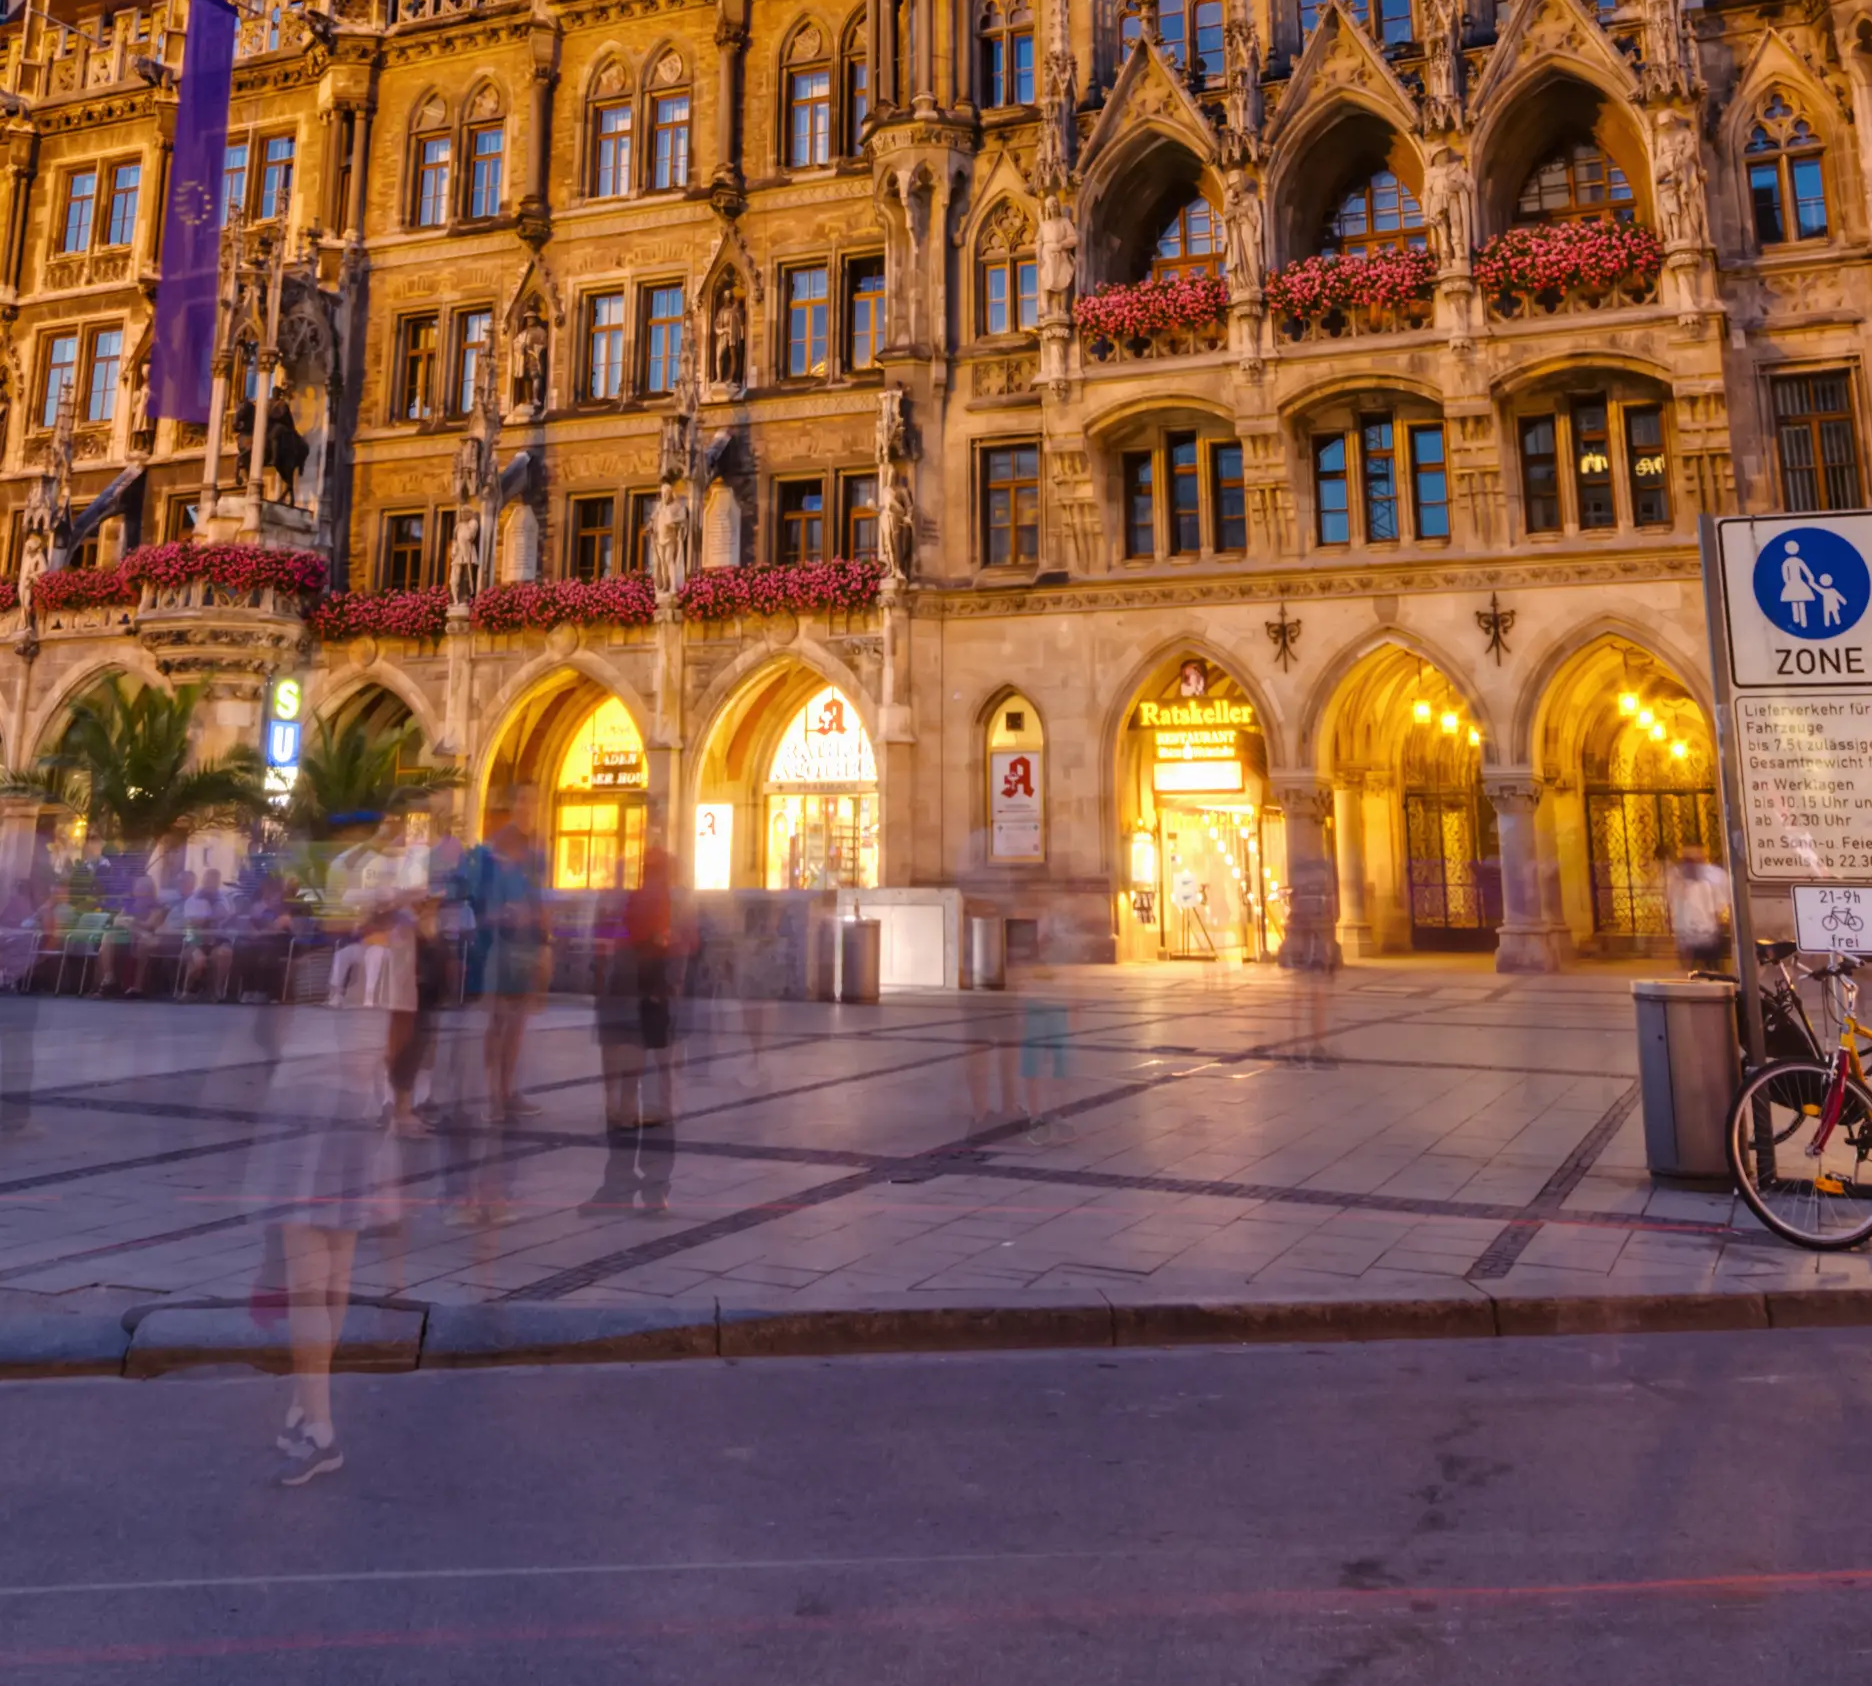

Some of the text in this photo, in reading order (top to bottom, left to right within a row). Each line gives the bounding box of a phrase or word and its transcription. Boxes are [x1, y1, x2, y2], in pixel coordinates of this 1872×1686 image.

[1775, 647, 1865, 675] ZONE
[276, 680, 299, 720] S
[1140, 700, 1253, 726] Ratskeller
[1744, 702, 1871, 717] Lieferverkehr für
[1746, 721, 1824, 735] Fahrzeuge
[273, 725, 295, 762] U
[1748, 739, 1769, 750] bis
[1749, 756, 1864, 771] Gesamtgewicht
[1752, 778, 1855, 794] an Werktagen
[1754, 796, 1774, 809] bis
[1780, 796, 1816, 808] 10.15
[1822, 796, 1849, 808] Uhr
[1755, 814, 1852, 827] ab 22.30 Uhr
[1757, 838, 1775, 849] an
[1758, 855, 1812, 869] jeweils
[1819, 890, 1861, 904] 21-9h
[1831, 934, 1860, 948] frei
